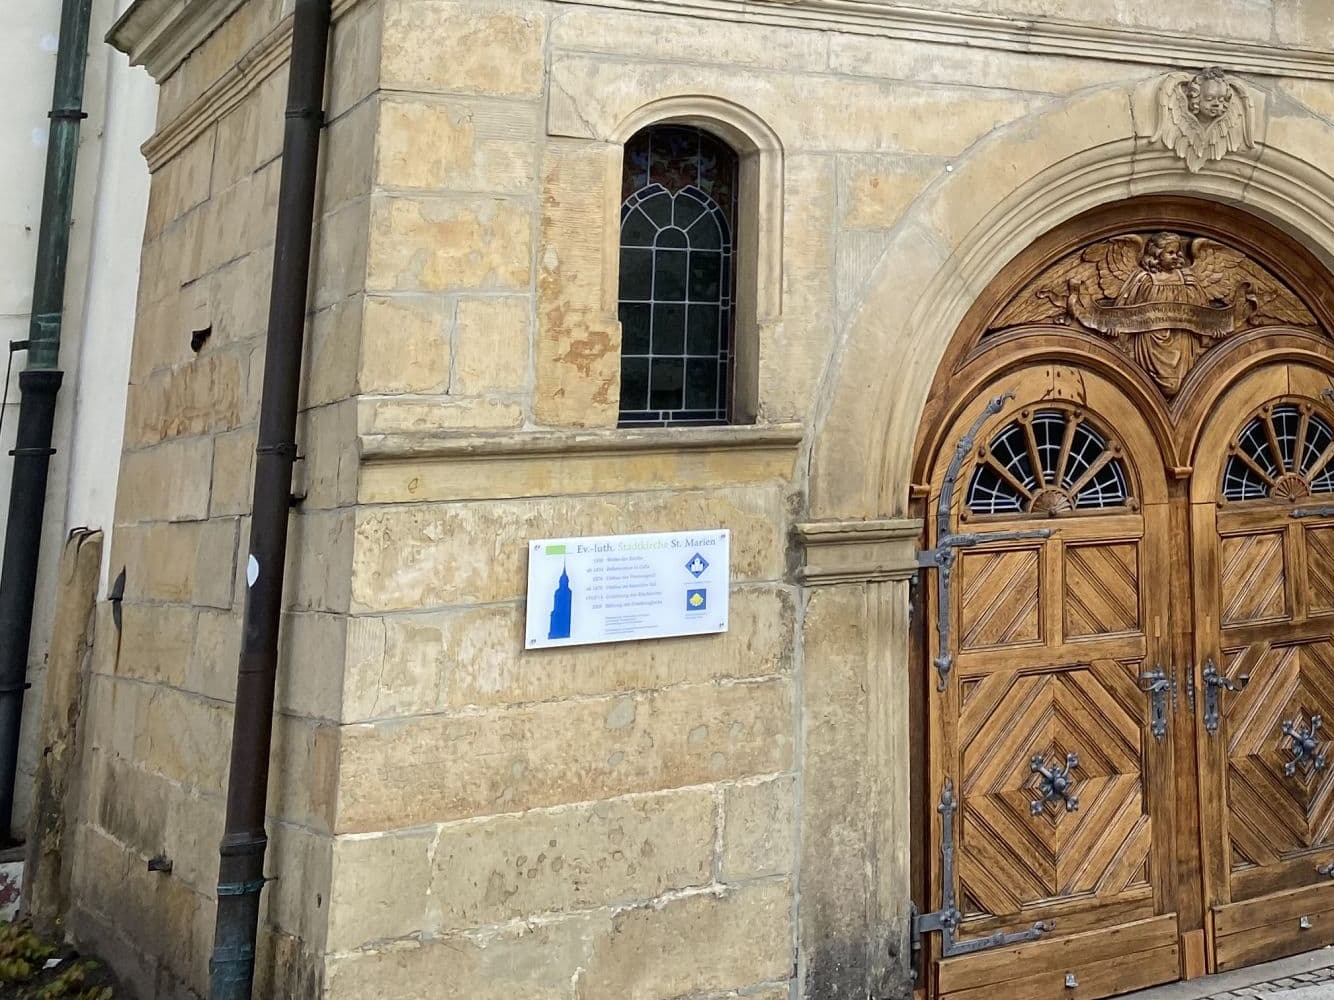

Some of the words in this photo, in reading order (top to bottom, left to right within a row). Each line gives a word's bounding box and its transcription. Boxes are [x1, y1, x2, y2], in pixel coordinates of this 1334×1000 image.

[577, 543, 614, 554] Ev.-luth.
[618, 539, 669, 552] Stadtkirche
[671, 539, 681, 548] St.
[685, 538, 716, 548] Marien
